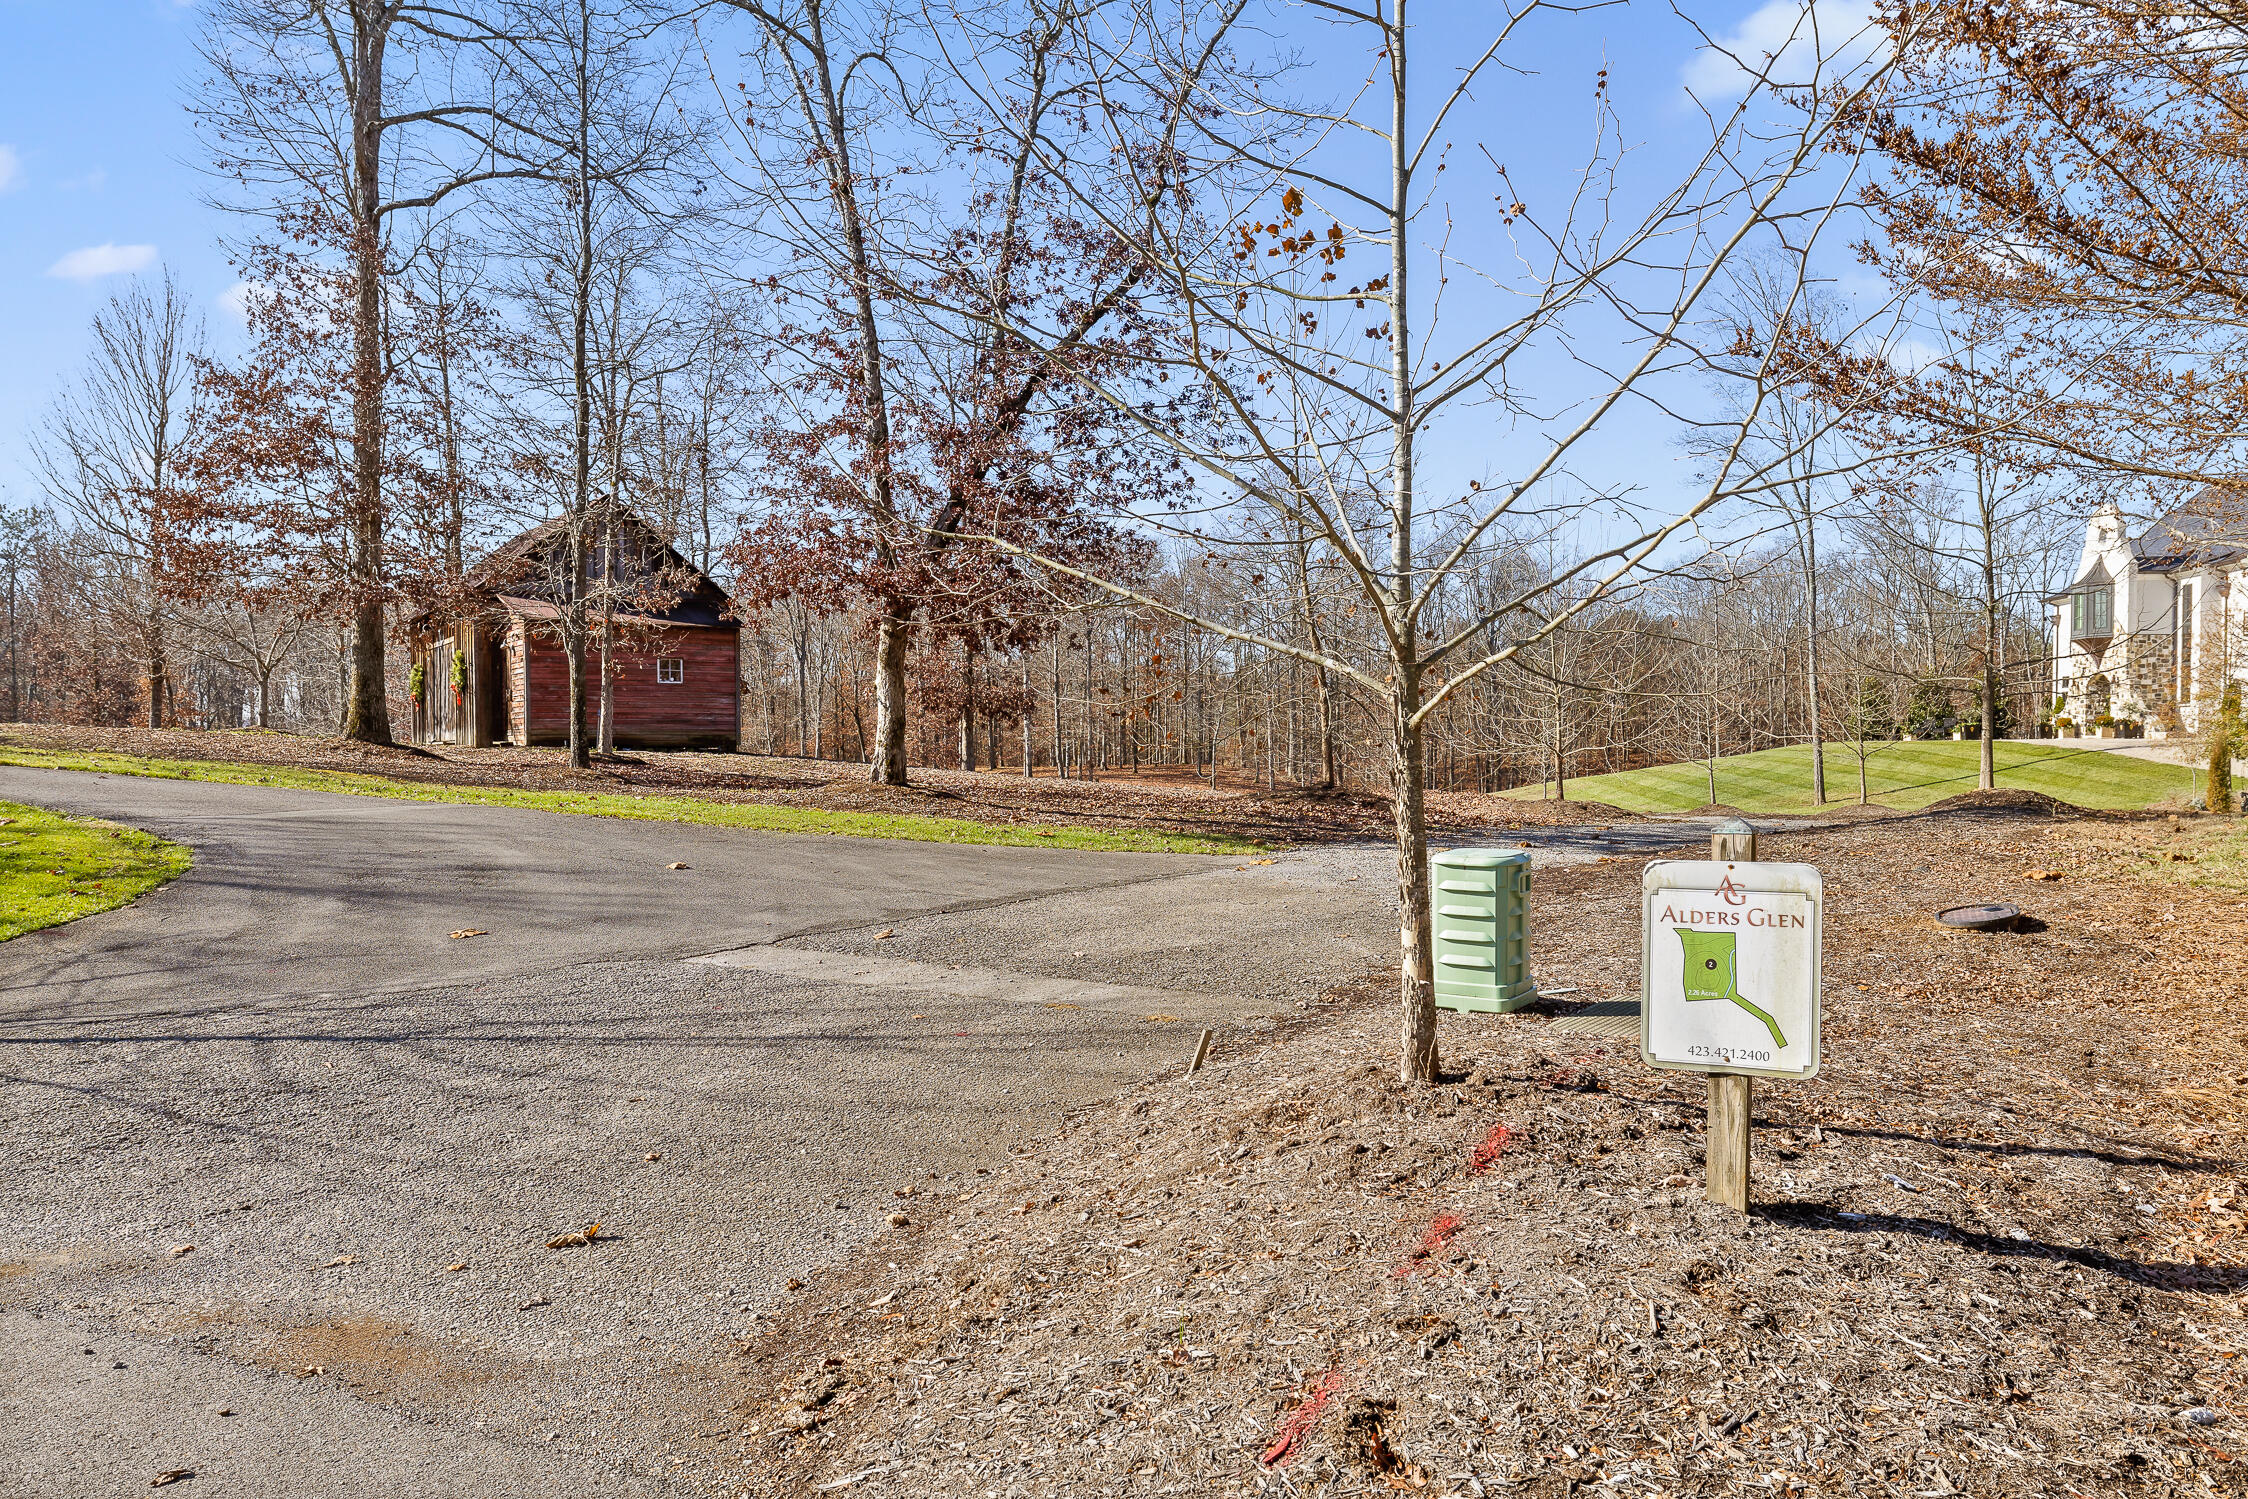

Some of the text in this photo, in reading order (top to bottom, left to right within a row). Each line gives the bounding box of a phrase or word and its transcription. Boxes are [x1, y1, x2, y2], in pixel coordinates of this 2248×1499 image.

[1714, 874, 1746, 906] AG
[1660, 904, 1805, 929] ALDERS GLEN
[1700, 989, 1719, 997] Acres
[1687, 1045, 1770, 1062] 423.421.2400
